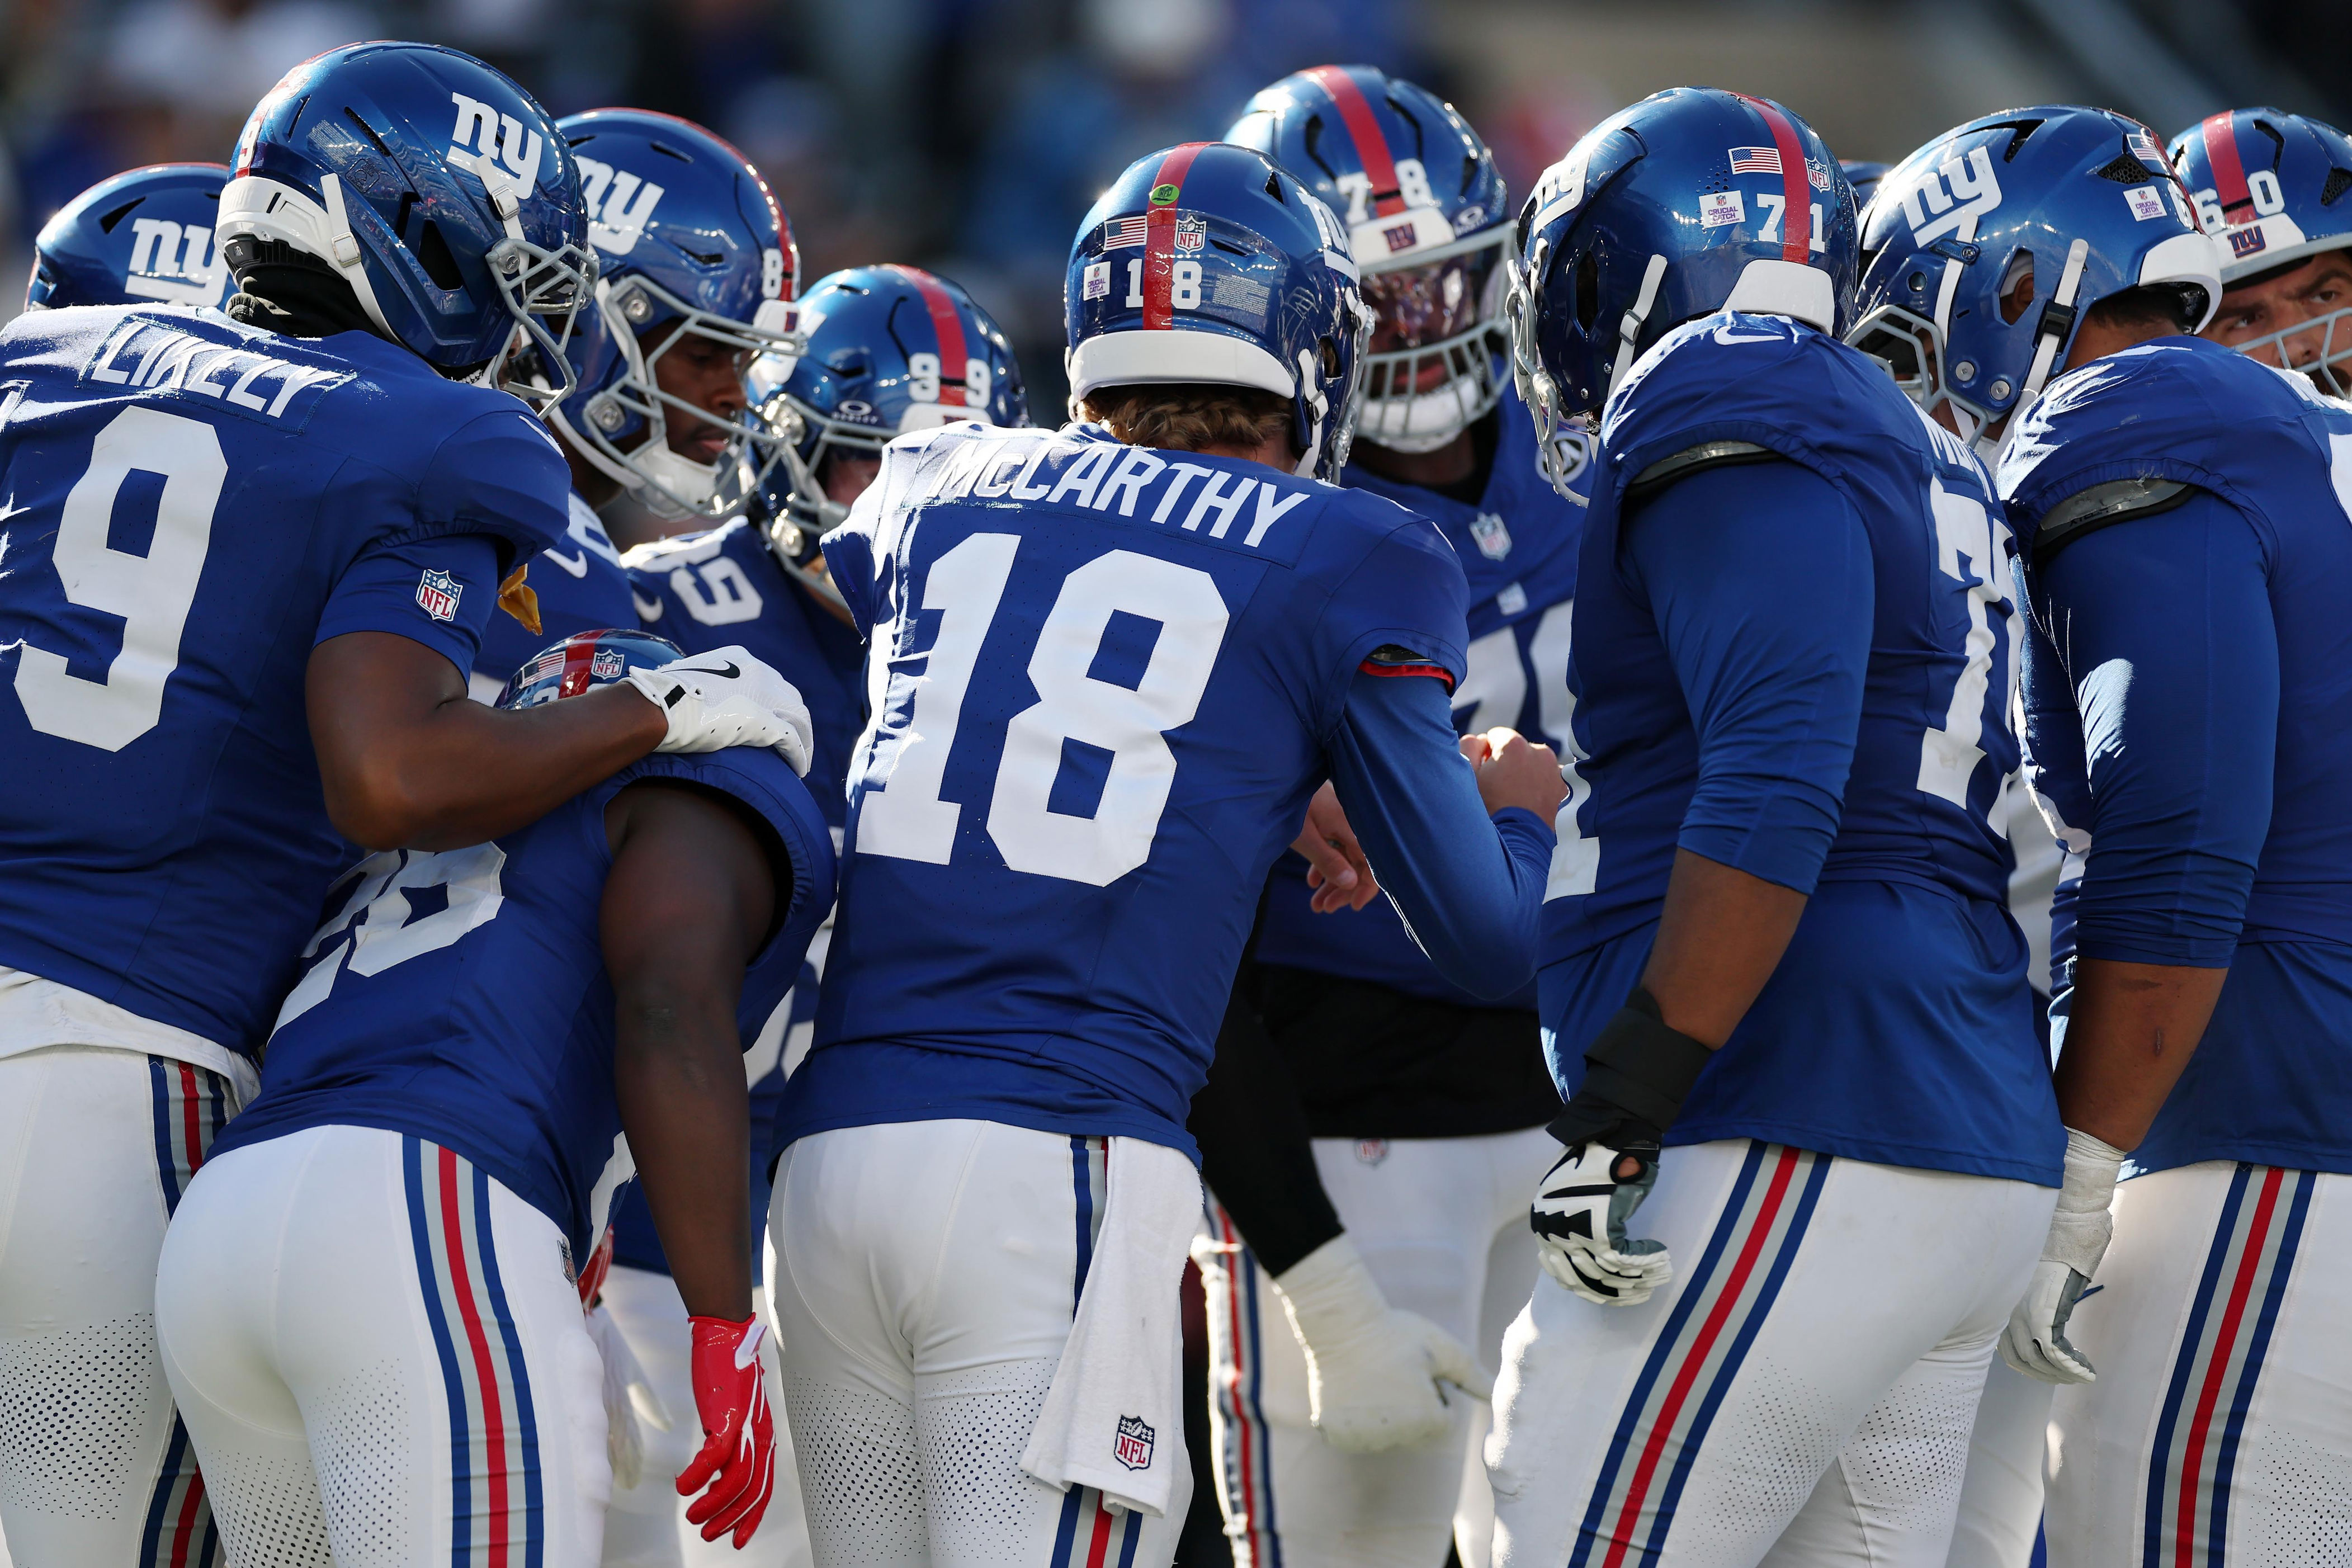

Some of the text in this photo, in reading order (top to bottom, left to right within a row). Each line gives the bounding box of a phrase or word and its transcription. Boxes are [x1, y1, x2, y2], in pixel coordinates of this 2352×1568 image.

[1336, 158, 1433, 224] 78
[1811, 170, 1828, 186] NFL
[1708, 206, 1739, 216] CRUCIAL
[1712, 212, 1736, 221] CATCH
[2135, 200, 2159, 209] CRUCIAL
[2193, 169, 2285, 235] 60
[1757, 193, 1826, 253] 71
[1179, 233, 1201, 248] NFL
[2227, 225, 2266, 259] ny
[1088, 278, 1106, 287] CRUCIAL
[1126, 258, 1203, 310] 18
[1231, 274, 1258, 285] WARNING
[91, 320, 343, 418] LIKELY
[13, 404, 229, 752] 9
[421, 586, 451, 617] NFL
[595, 663, 618, 676] NFL
[855, 532, 1230, 887] 18
[1117, 1435, 1146, 1464] NFL
